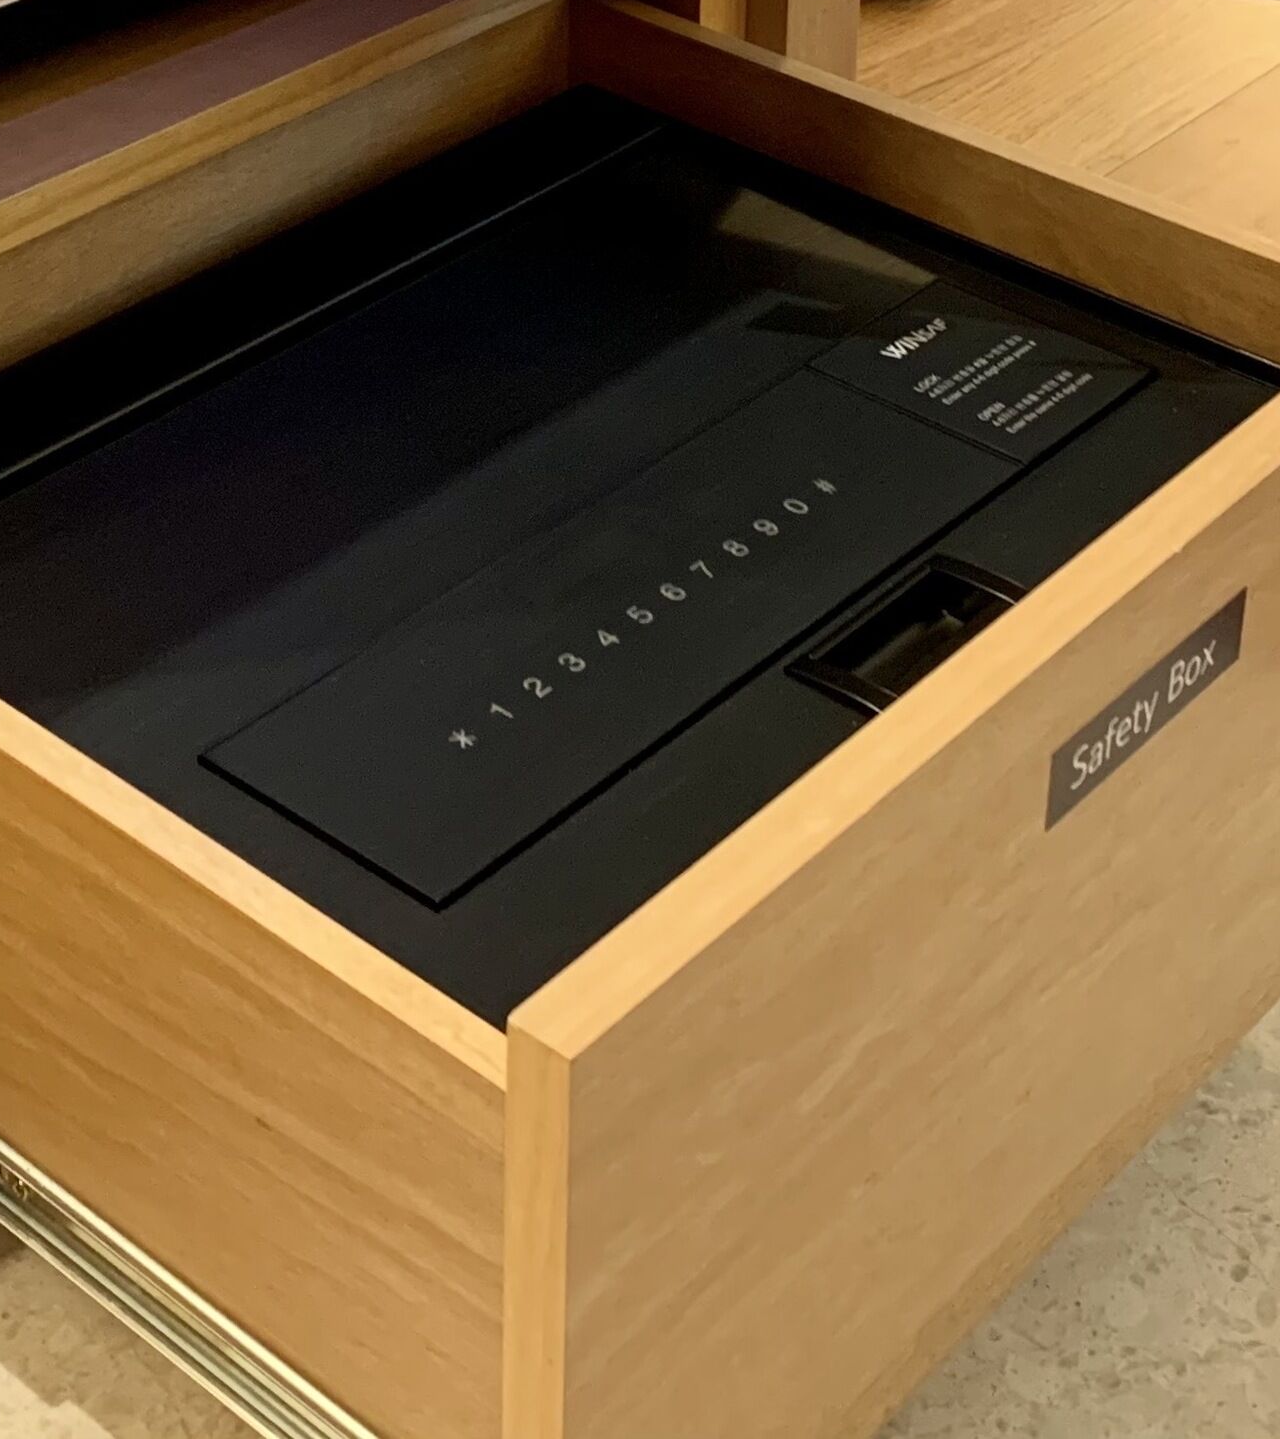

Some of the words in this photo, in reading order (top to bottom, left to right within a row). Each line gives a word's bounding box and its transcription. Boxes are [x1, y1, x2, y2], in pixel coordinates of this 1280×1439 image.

[490, 702, 514, 720] 1
[523, 676, 553, 699] 2
[558, 652, 586, 673] 3
[596, 628, 620, 648] 4
[626, 605, 654, 625] 5
[659, 582, 687, 602] 6
[689, 560, 715, 579] 7
[722, 539, 750, 558] 8
[753, 519, 780, 537] 9
[782, 498, 810, 516] 0
[813, 477, 838, 496] #
[1070, 691, 1160, 791] Safety
[1167, 639, 1217, 704] Box
